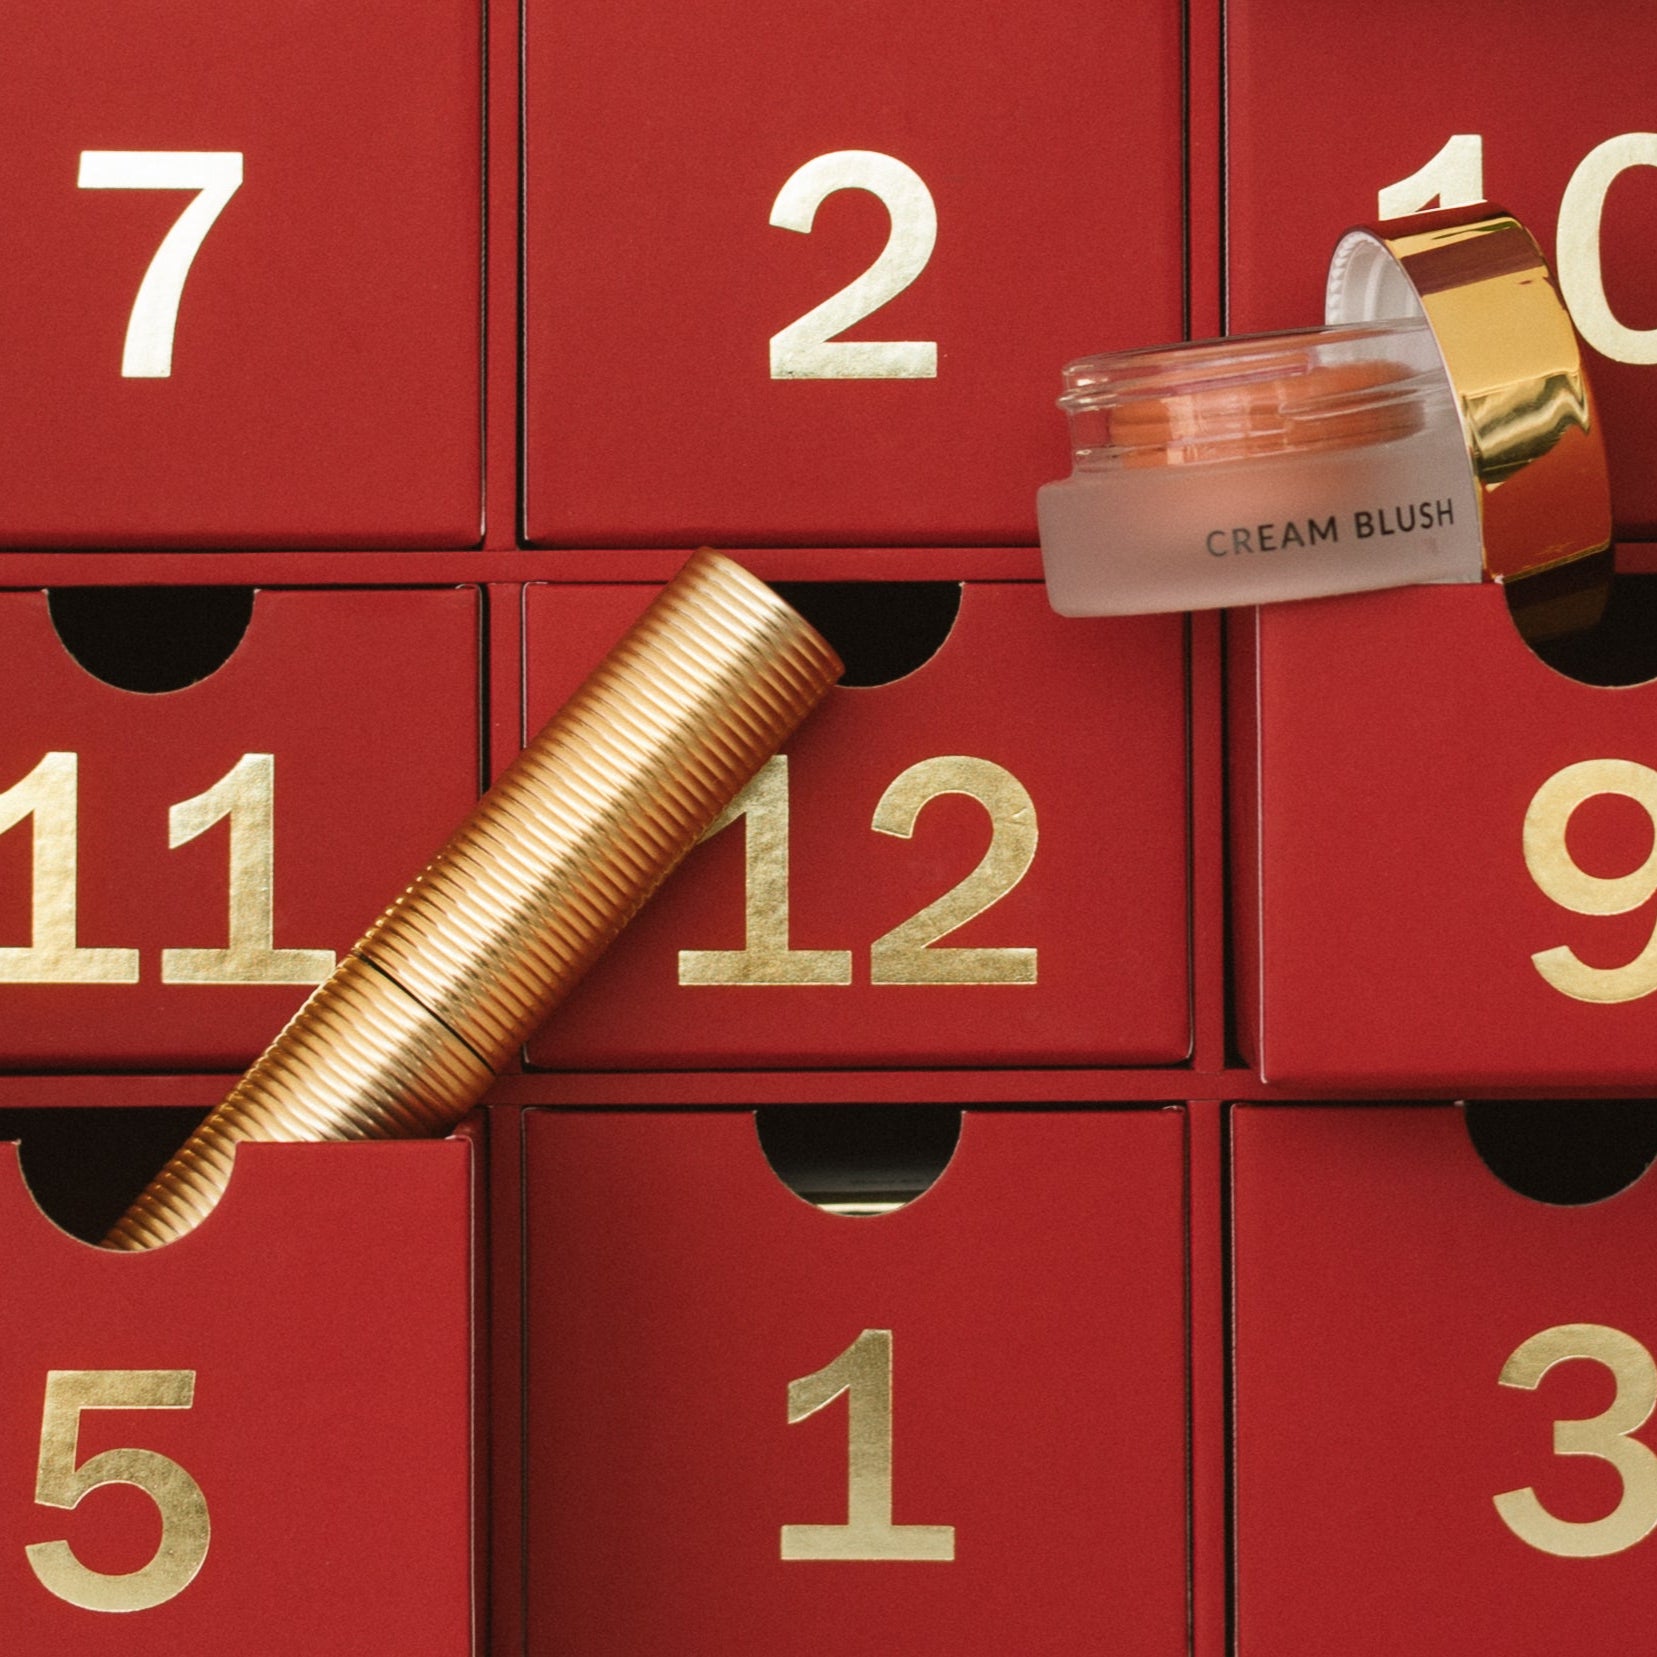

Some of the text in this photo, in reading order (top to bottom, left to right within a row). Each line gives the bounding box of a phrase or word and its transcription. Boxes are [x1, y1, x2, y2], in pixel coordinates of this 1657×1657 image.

[76, 150, 244, 379] 7
[768, 149, 939, 381] 2
[1206, 498, 1456, 558] CREAM BLUSH
[0, 751, 338, 986] 11
[677, 754, 1040, 986] 12
[1522, 758, 1657, 1005] 9
[24, 1368, 212, 1614] 5
[779, 1328, 956, 1562] 1
[1492, 1322, 1657, 1559] 3
